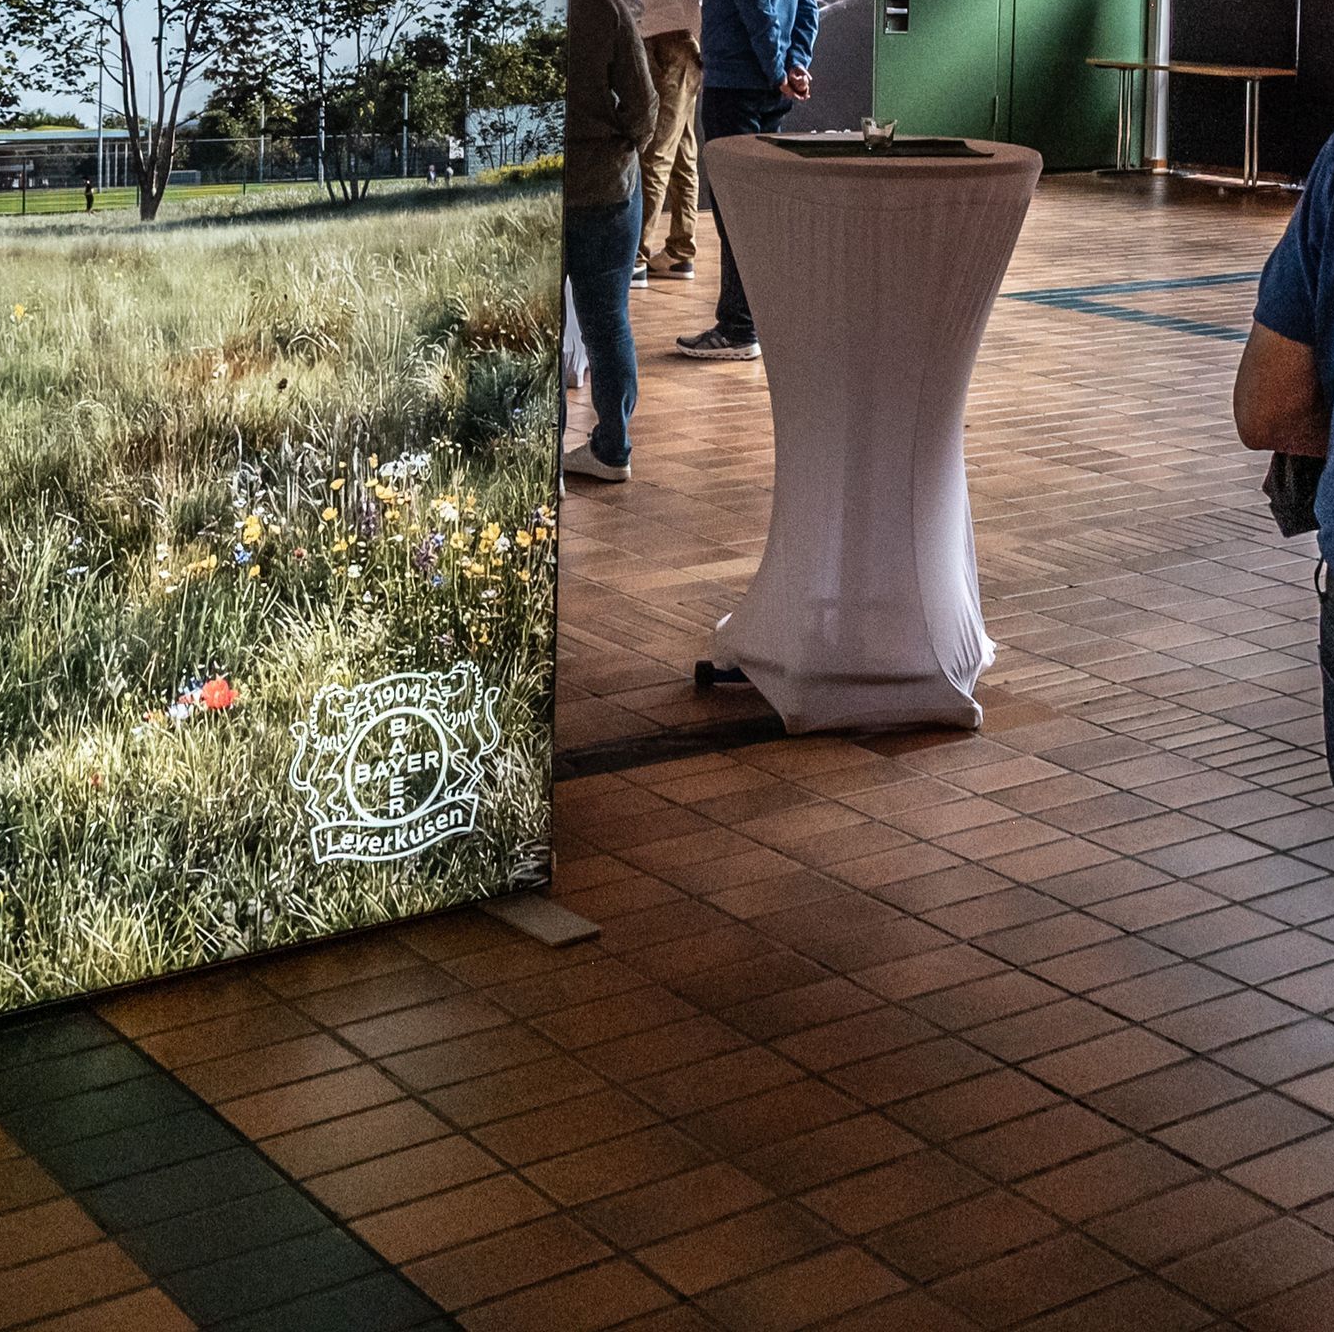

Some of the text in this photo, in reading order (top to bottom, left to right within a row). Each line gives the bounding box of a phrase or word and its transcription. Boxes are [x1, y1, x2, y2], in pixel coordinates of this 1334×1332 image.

[374, 683, 421, 709] 1904
[354, 751, 440, 784] BAYER
[388, 717, 407, 817] BAYER
[326, 807, 464, 855] Leverkusen
